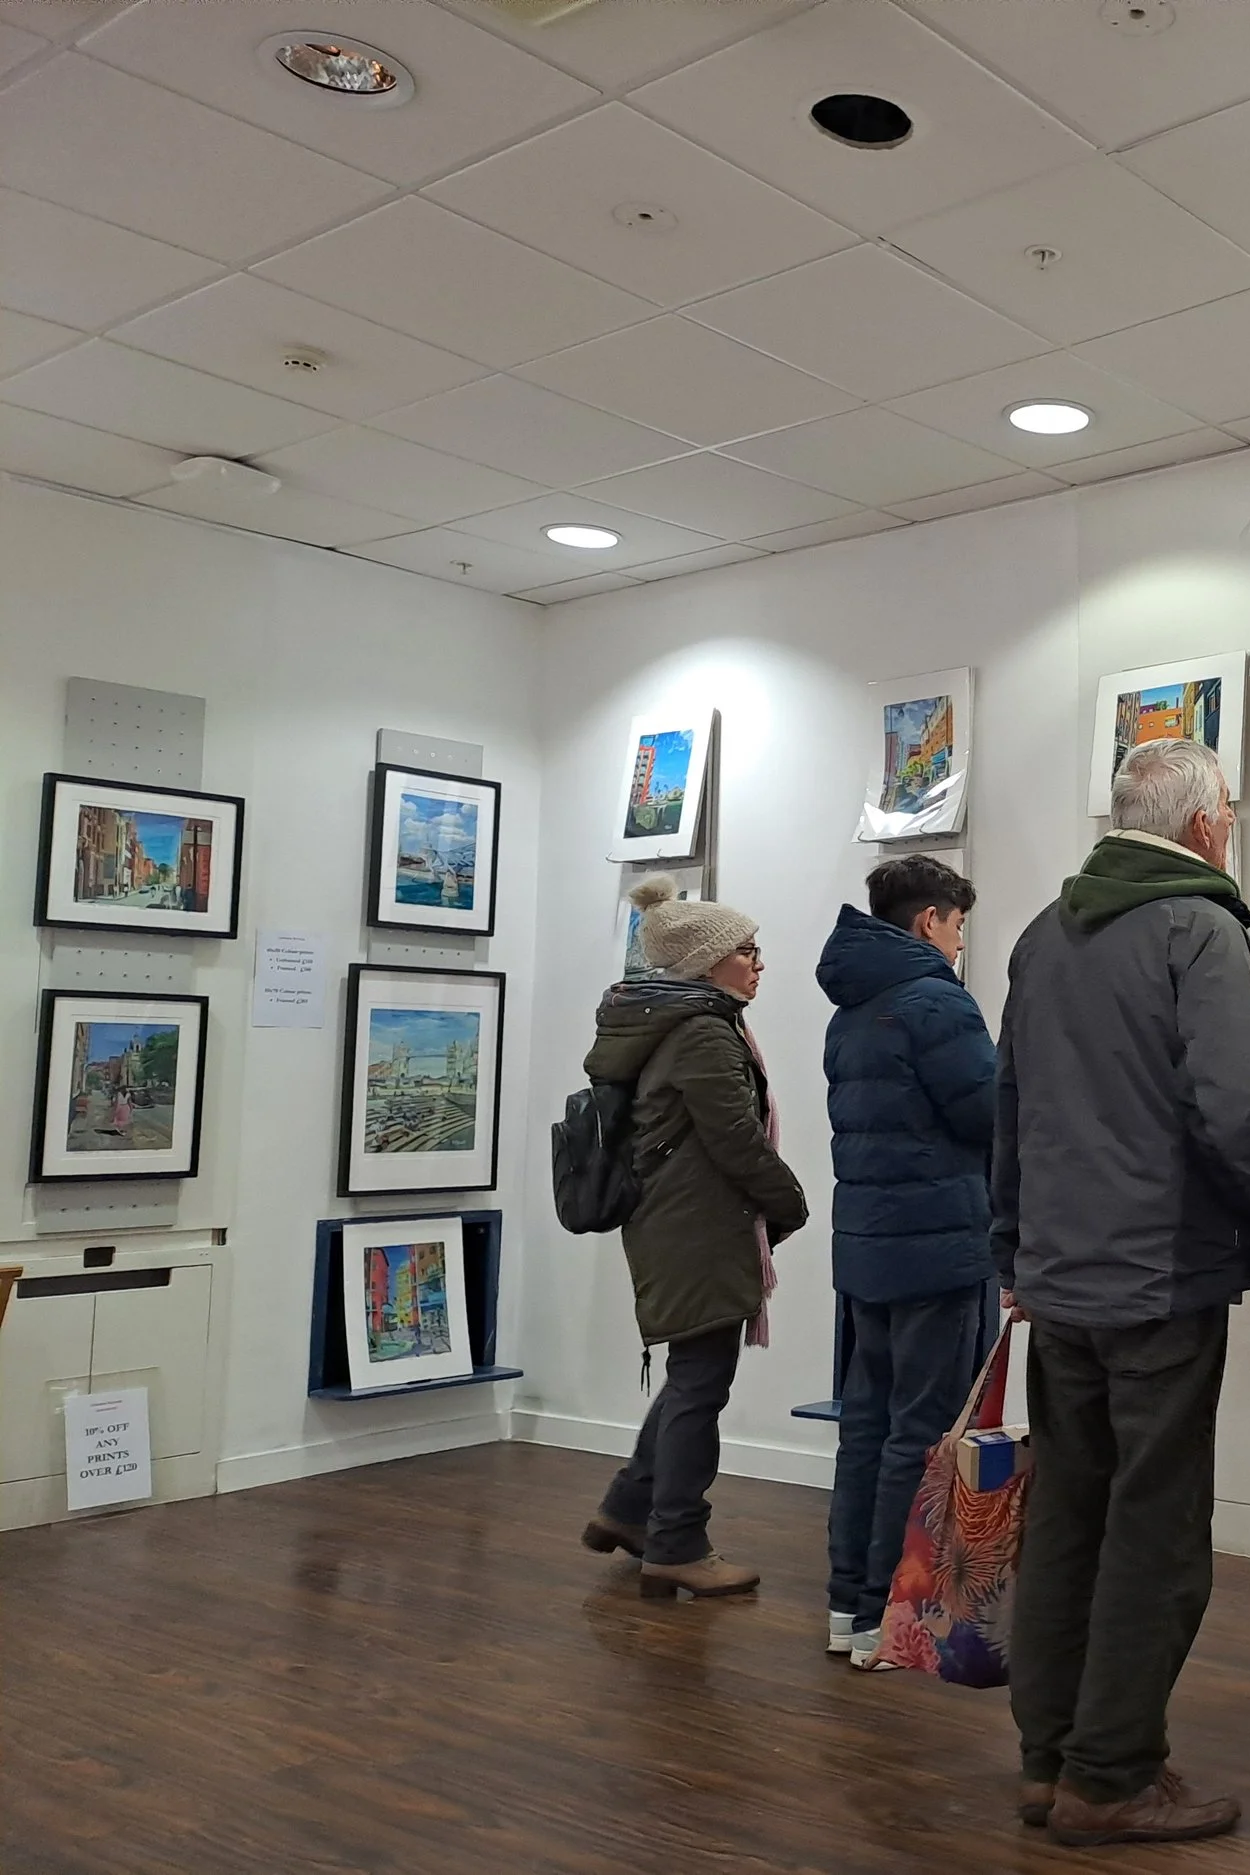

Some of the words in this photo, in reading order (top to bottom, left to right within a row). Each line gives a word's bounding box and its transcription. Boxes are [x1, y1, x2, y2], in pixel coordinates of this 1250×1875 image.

[85, 1427, 104, 1436] 10%
[107, 1422, 130, 1433] OFF
[95, 1438, 120, 1449] ANY
[87, 1450, 130, 1464] PRINTS
[80, 1466, 112, 1479] OVER
[115, 1462, 138, 1476] £120
